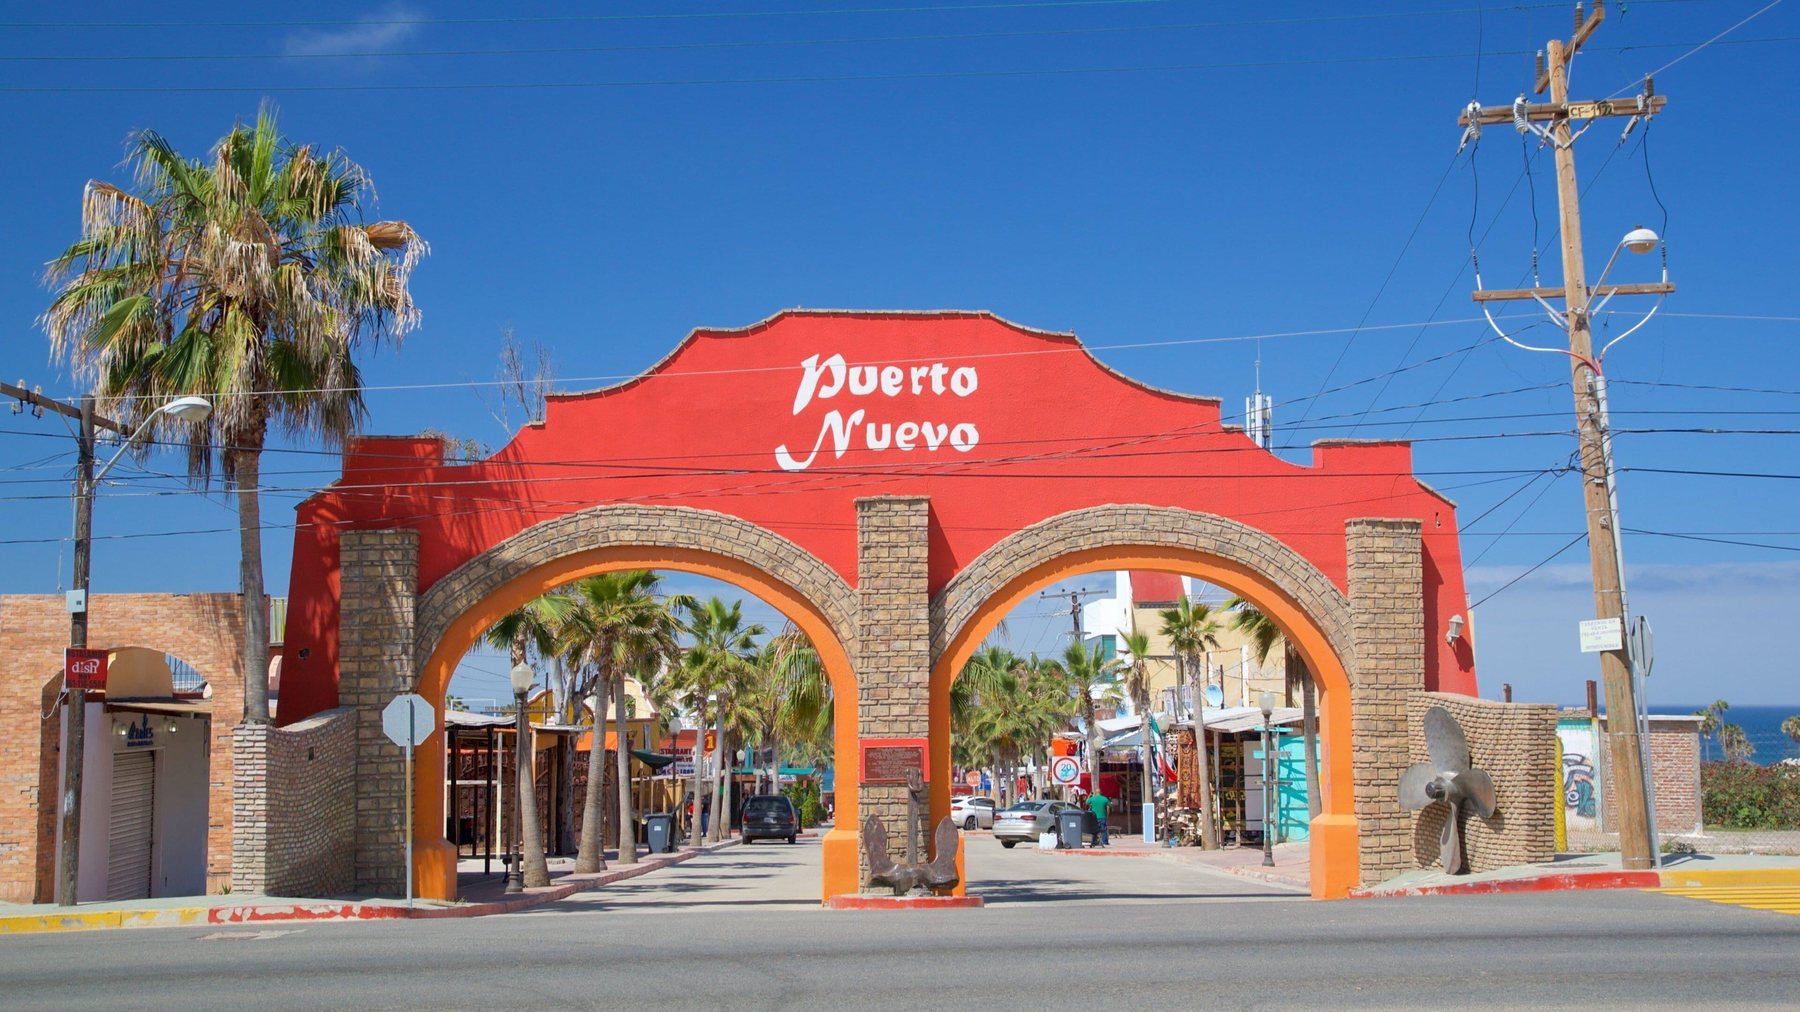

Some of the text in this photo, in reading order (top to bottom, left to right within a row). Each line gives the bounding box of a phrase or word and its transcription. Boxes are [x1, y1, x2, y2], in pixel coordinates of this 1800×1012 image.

[792, 353, 978, 416] Puerto
[774, 409, 980, 472] Nuevo
[71, 659, 100, 673] dish
[1060, 762, 1072, 772] 20
